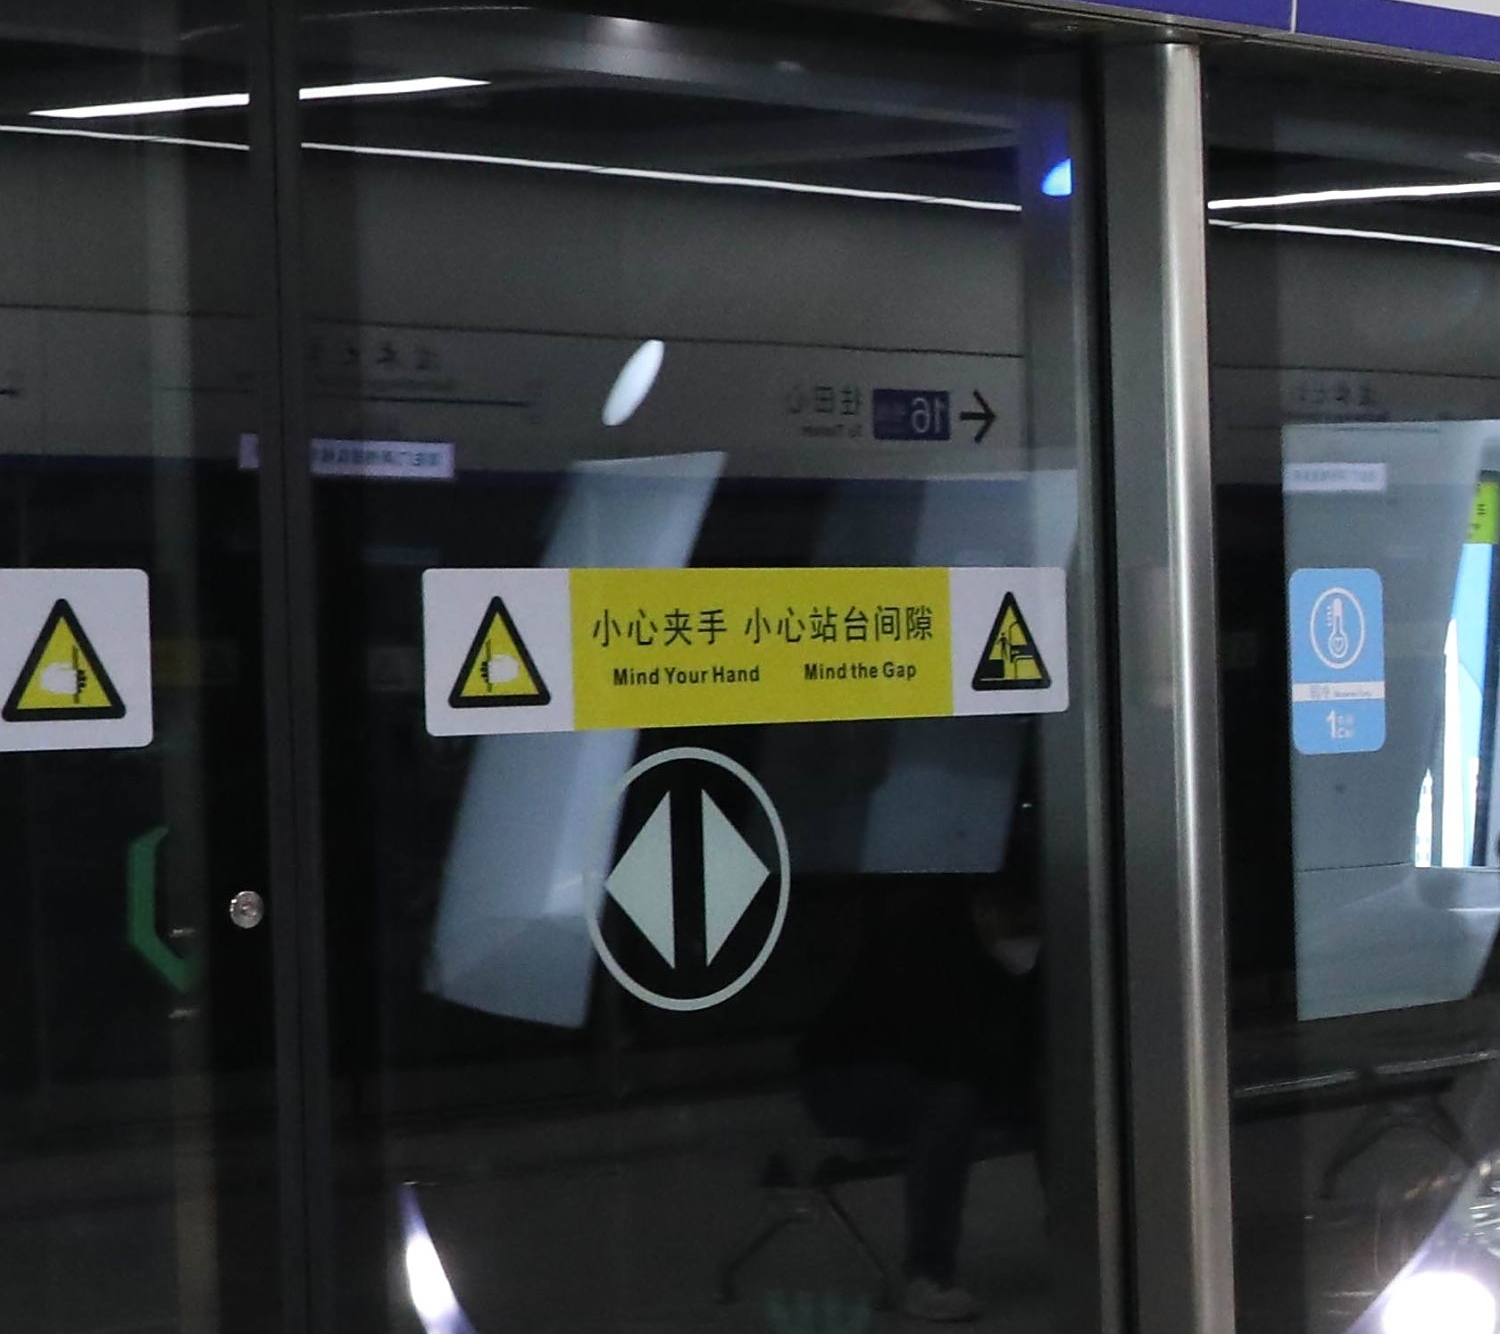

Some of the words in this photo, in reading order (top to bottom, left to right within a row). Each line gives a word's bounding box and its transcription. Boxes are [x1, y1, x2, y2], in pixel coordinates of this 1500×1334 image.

[592, 607, 729, 649] 小心夹手
[744, 605, 935, 645] 小心站台间隙
[612, 667, 660, 686] Mind
[664, 666, 709, 685] Your
[712, 665, 760, 684] Hand
[803, 662, 847, 681] Mind
[850, 662, 878, 679] the
[882, 661, 917, 681] Gap
